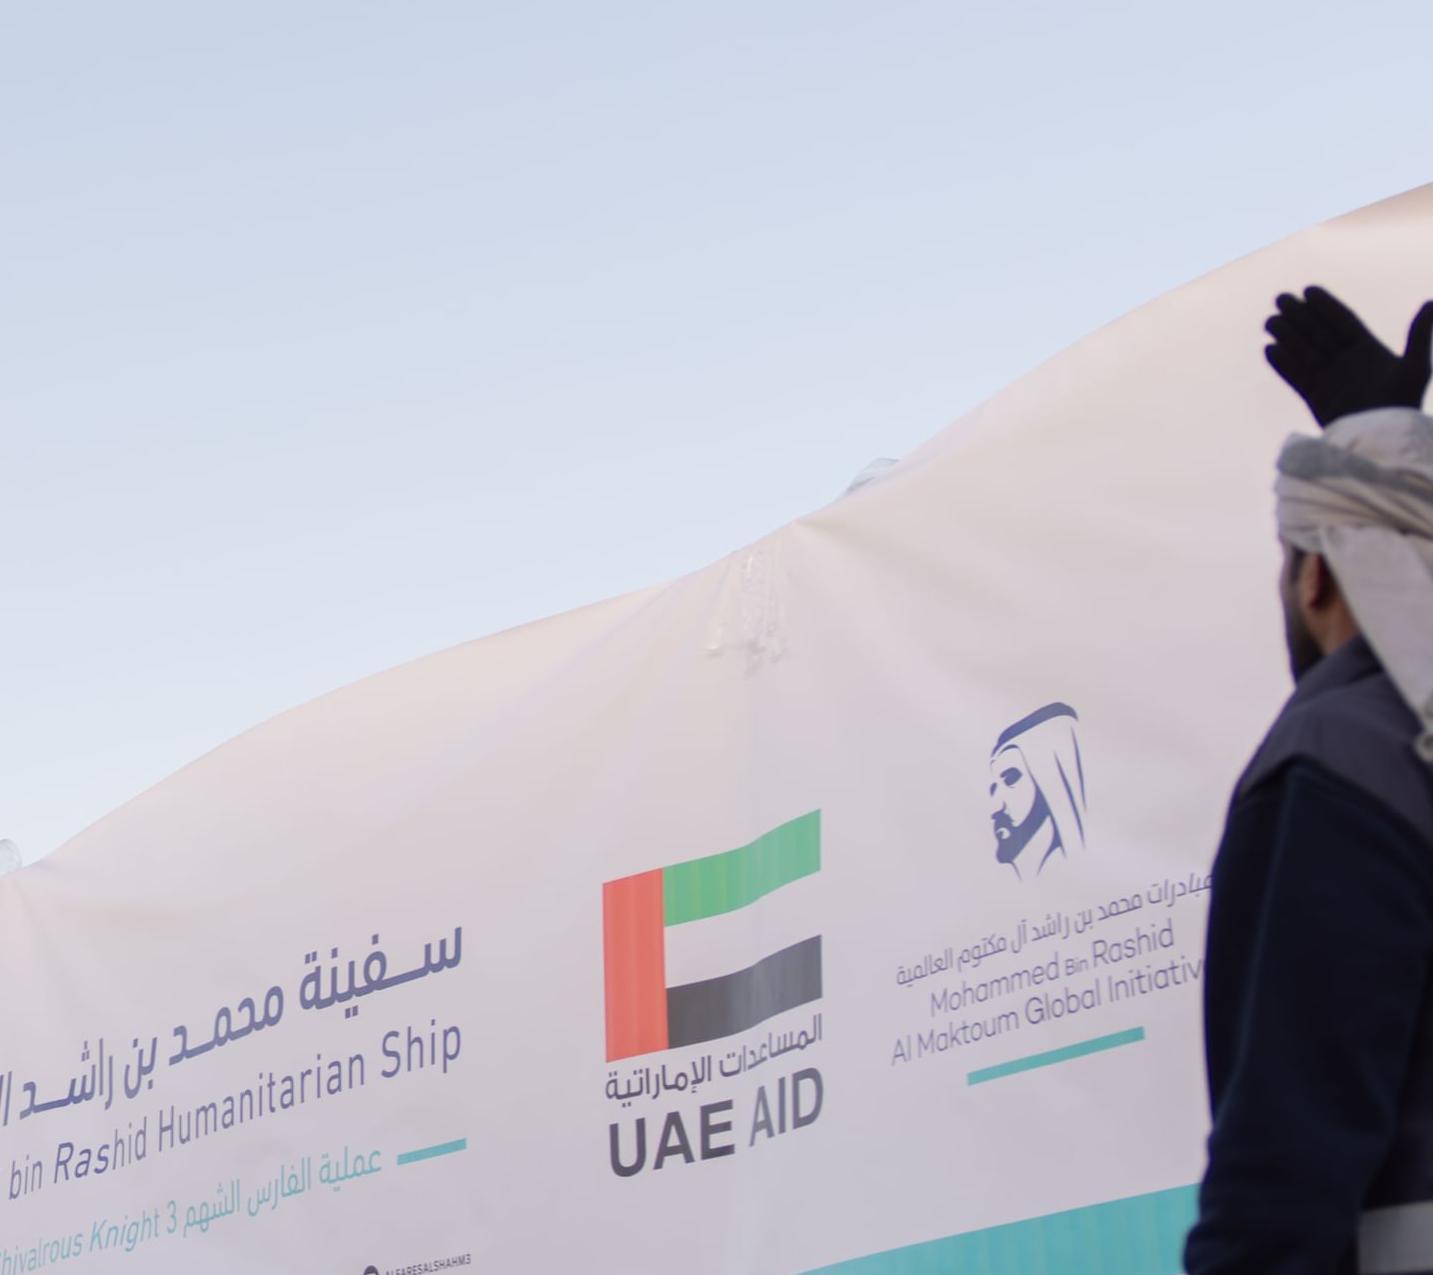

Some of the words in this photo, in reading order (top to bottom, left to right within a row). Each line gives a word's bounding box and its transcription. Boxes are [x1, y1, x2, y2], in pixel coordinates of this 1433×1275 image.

[1010, 919, 1027, 954] آل
[1031, 912, 1070, 942] راشد
[1074, 909, 1093, 934] بن
[1098, 893, 1143, 921] محمد
[299, 926, 462, 1019] سفينة
[895, 947, 954, 987] العالمية
[930, 952, 1060, 1017] Mohammed
[1065, 956, 1089, 976] Bin
[1092, 918, 1174, 968] Rashid
[957, 934, 1007, 973] مكتوم
[168, 985, 284, 1066] محمد
[891, 1035, 912, 1066] Al
[917, 1011, 1019, 1057] Maktoum
[1025, 978, 1102, 1025] Global
[1108, 955, 1205, 1003] Initiativ
[124, 1036, 158, 1100] بن
[719, 1013, 822, 1078] المساعدات
[19, 1037, 113, 1120] راشد
[605, 1054, 712, 1108] الإماراتية
[8, 1154, 43, 1201] bin
[53, 1116, 147, 1184] Rashid
[158, 1053, 365, 1153] Humanitarian
[381, 1019, 461, 1079] Ship
[609, 1099, 735, 1178] UAE
[749, 1067, 824, 1148] AID
[246, 1156, 311, 1217] الفارس
[319, 1146, 382, 1192] عملية
[89, 1204, 160, 1253] Knight
[166, 1199, 177, 1235] 3
[183, 1178, 240, 1238] الشهم
